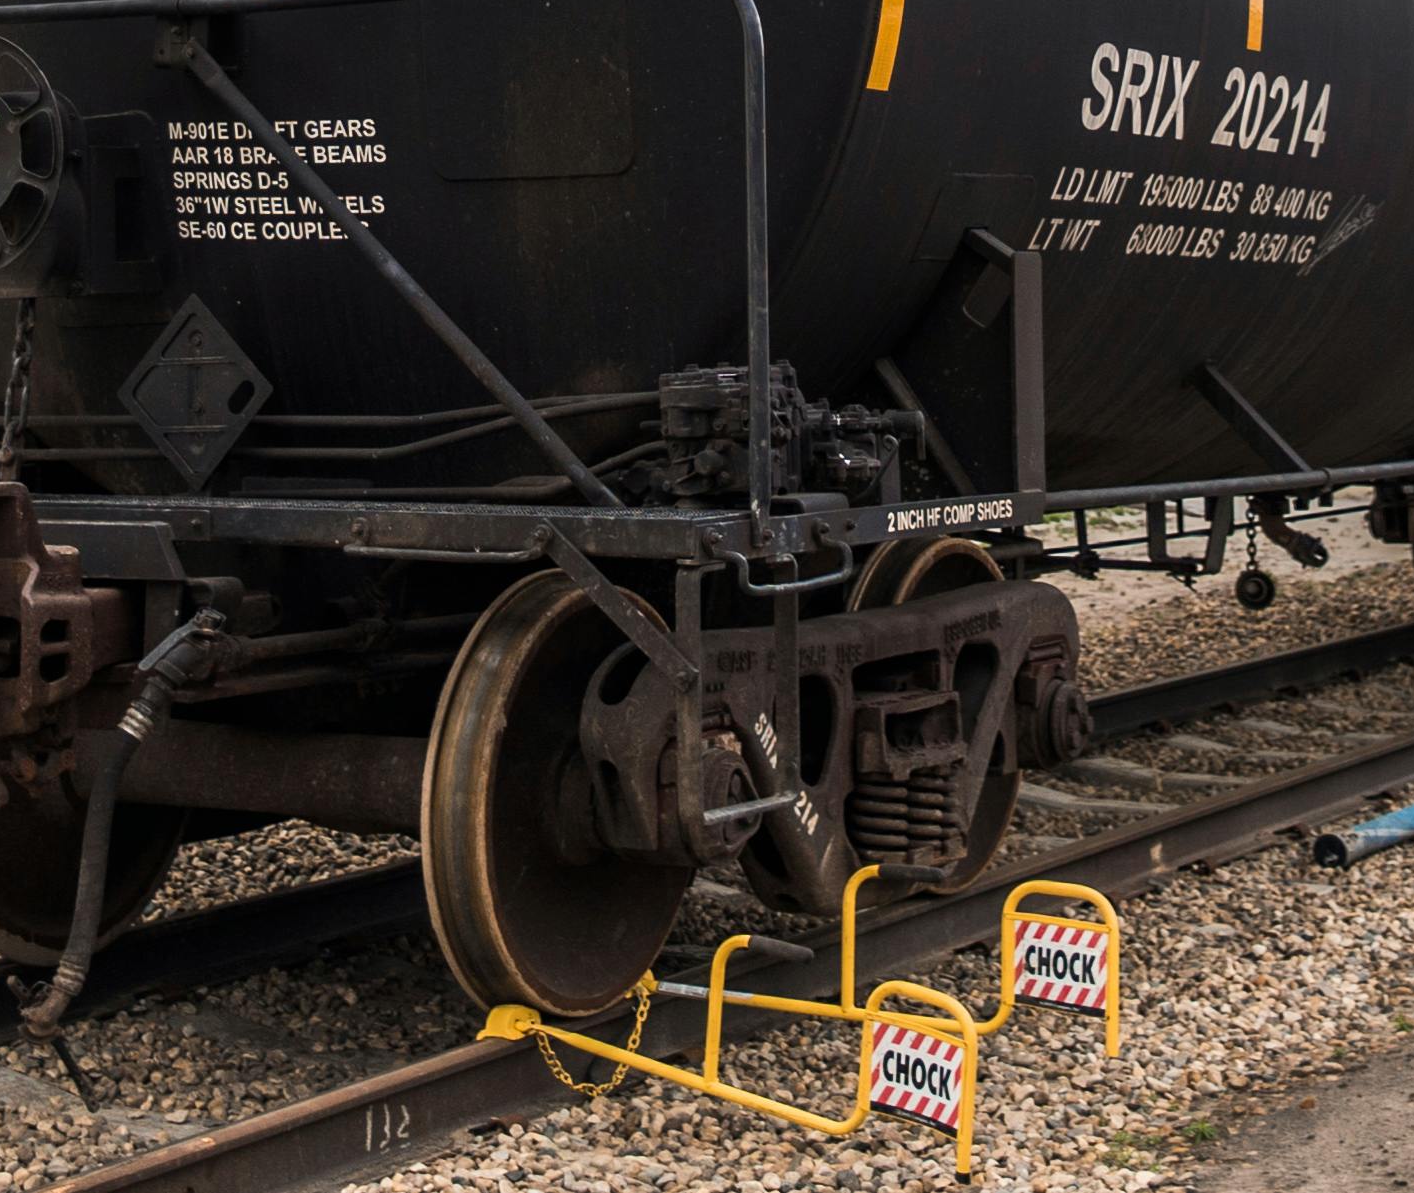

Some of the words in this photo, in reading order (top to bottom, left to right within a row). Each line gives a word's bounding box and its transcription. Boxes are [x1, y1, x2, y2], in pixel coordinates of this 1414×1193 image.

[1081, 42, 1200, 140] SRIX
[1211, 66, 1331, 158] 20214
[168, 122, 229, 140] M-901E
[234, 121, 298, 140] DFT
[303, 119, 376, 139] GEARS
[172, 146, 209, 164] AAR
[213, 146, 234, 164] 18
[240, 146, 308, 164] BRAE
[313, 144, 387, 164] BEAMS
[173, 171, 253, 190] SPRINGS
[257, 171, 289, 190] D-5
[1050, 166, 1084, 201] LD
[1083, 169, 1133, 204] LMT
[1139, 173, 1204, 210] 195000
[1202, 179, 1244, 214] LBS
[1250, 183, 1275, 216] 88
[1273, 186, 1306, 220] 400
[1303, 190, 1333, 221] KG
[234, 196, 295, 215] STEEL
[298, 195, 385, 215] WELS
[178, 221, 227, 240] SE-60
[231, 221, 257, 240] CE
[261, 221, 369, 240] COUPLE
[1028, 218, 1064, 251] LT
[1060, 219, 1101, 252] WT
[1125, 223, 1185, 256] 68000
[1180, 227, 1225, 259] LBS
[1229, 231, 1257, 261] 30
[1253, 233, 1288, 263] 850
[1283, 235, 1316, 265] KG
[887, 511, 896, 533] 2
[897, 508, 925, 531] INCH
[927, 507, 941, 527] HF
[943, 503, 975, 525] COMP
[977, 499, 1013, 522] SHOES
[1024, 944, 1097, 985] CHOCK
[882, 1049, 952, 1101] CHOCK
